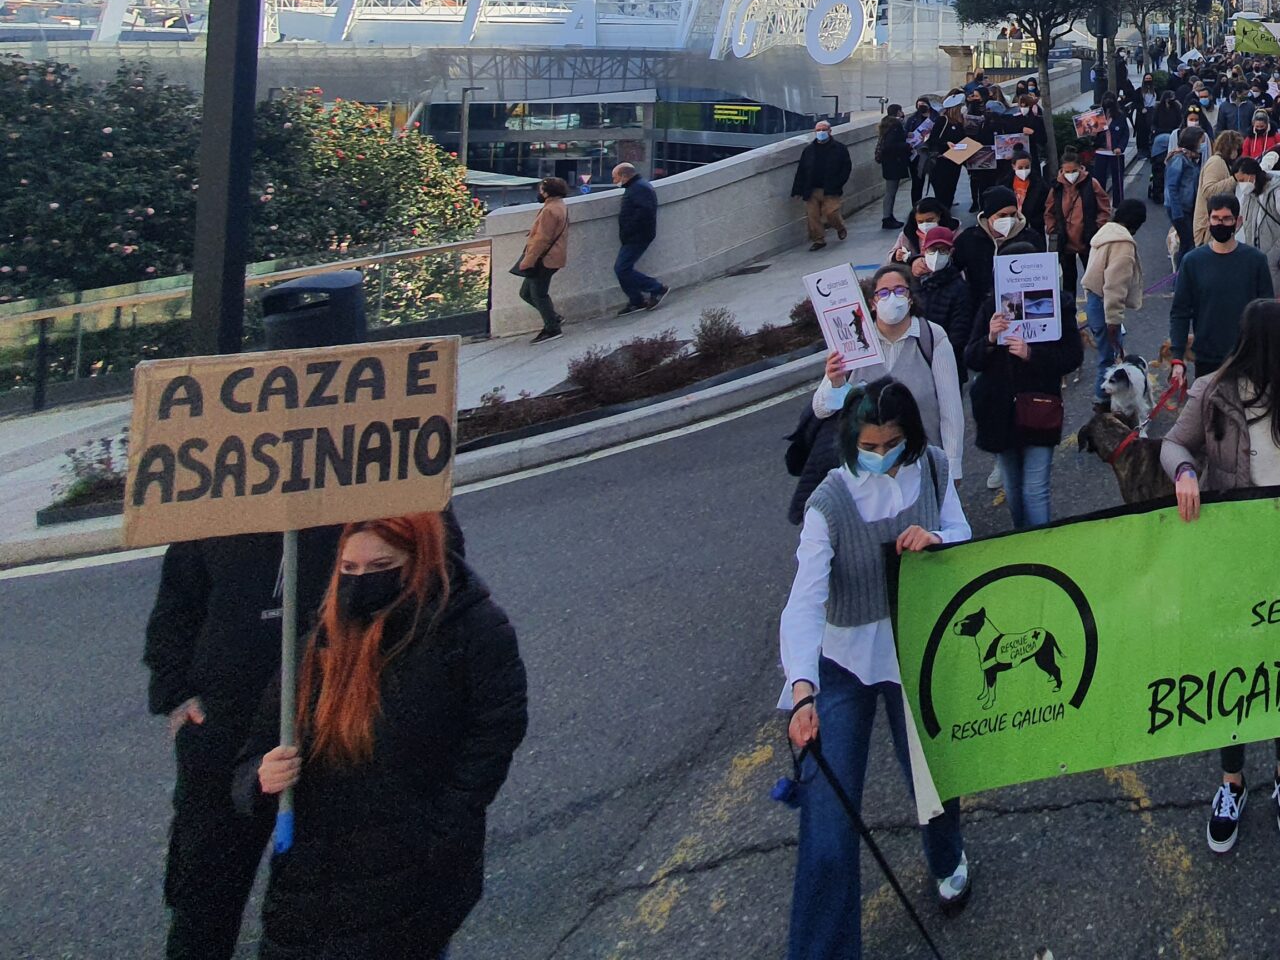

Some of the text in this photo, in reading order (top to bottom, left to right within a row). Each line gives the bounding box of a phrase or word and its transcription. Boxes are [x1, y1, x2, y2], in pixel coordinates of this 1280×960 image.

[832, 316, 843, 329] NO
[1022, 322, 1031, 331] NO
[158, 342, 439, 421] A CAZA É
[132, 415, 452, 507] ASASINATO
[1000, 635, 1028, 654] RESCUE
[1010, 641, 1037, 660] GALICIA
[951, 702, 1065, 741] RESCUE GALICIA
